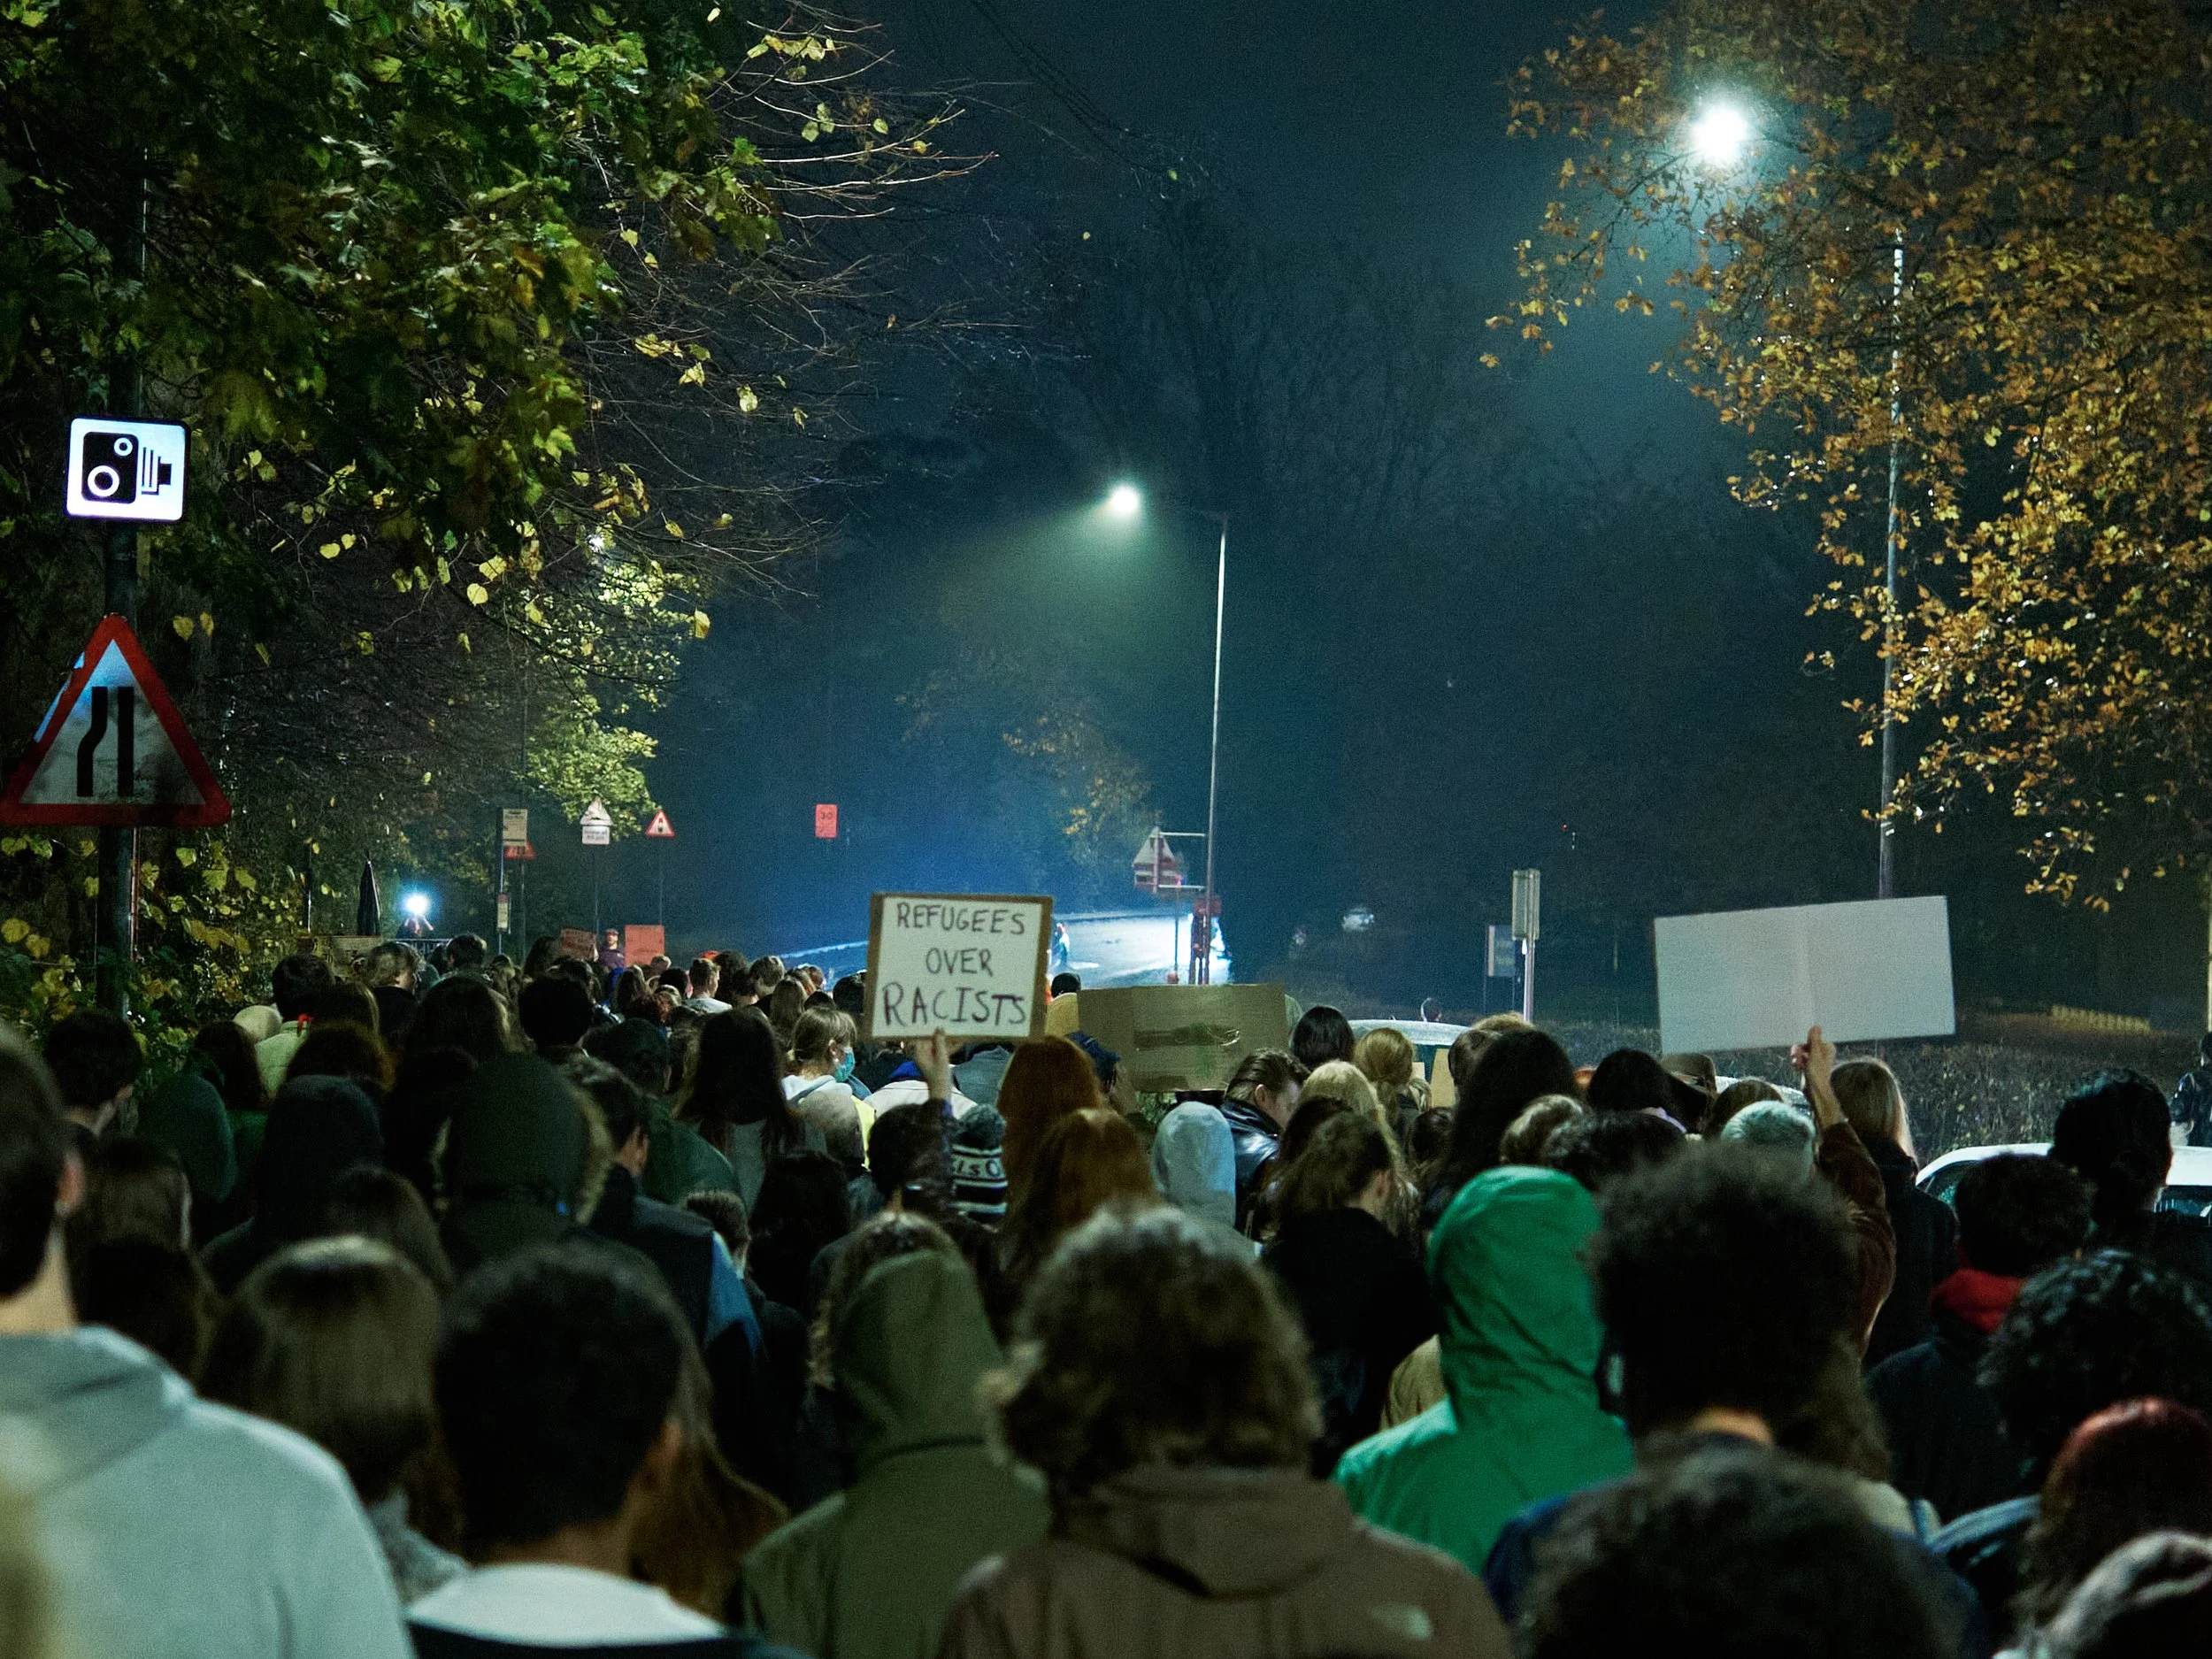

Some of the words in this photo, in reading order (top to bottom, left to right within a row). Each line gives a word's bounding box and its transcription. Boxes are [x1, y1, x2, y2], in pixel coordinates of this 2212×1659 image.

[896, 902, 1025, 935] REFUGEES
[926, 948, 993, 978] OVER
[881, 981, 1026, 1027] RACISTS
